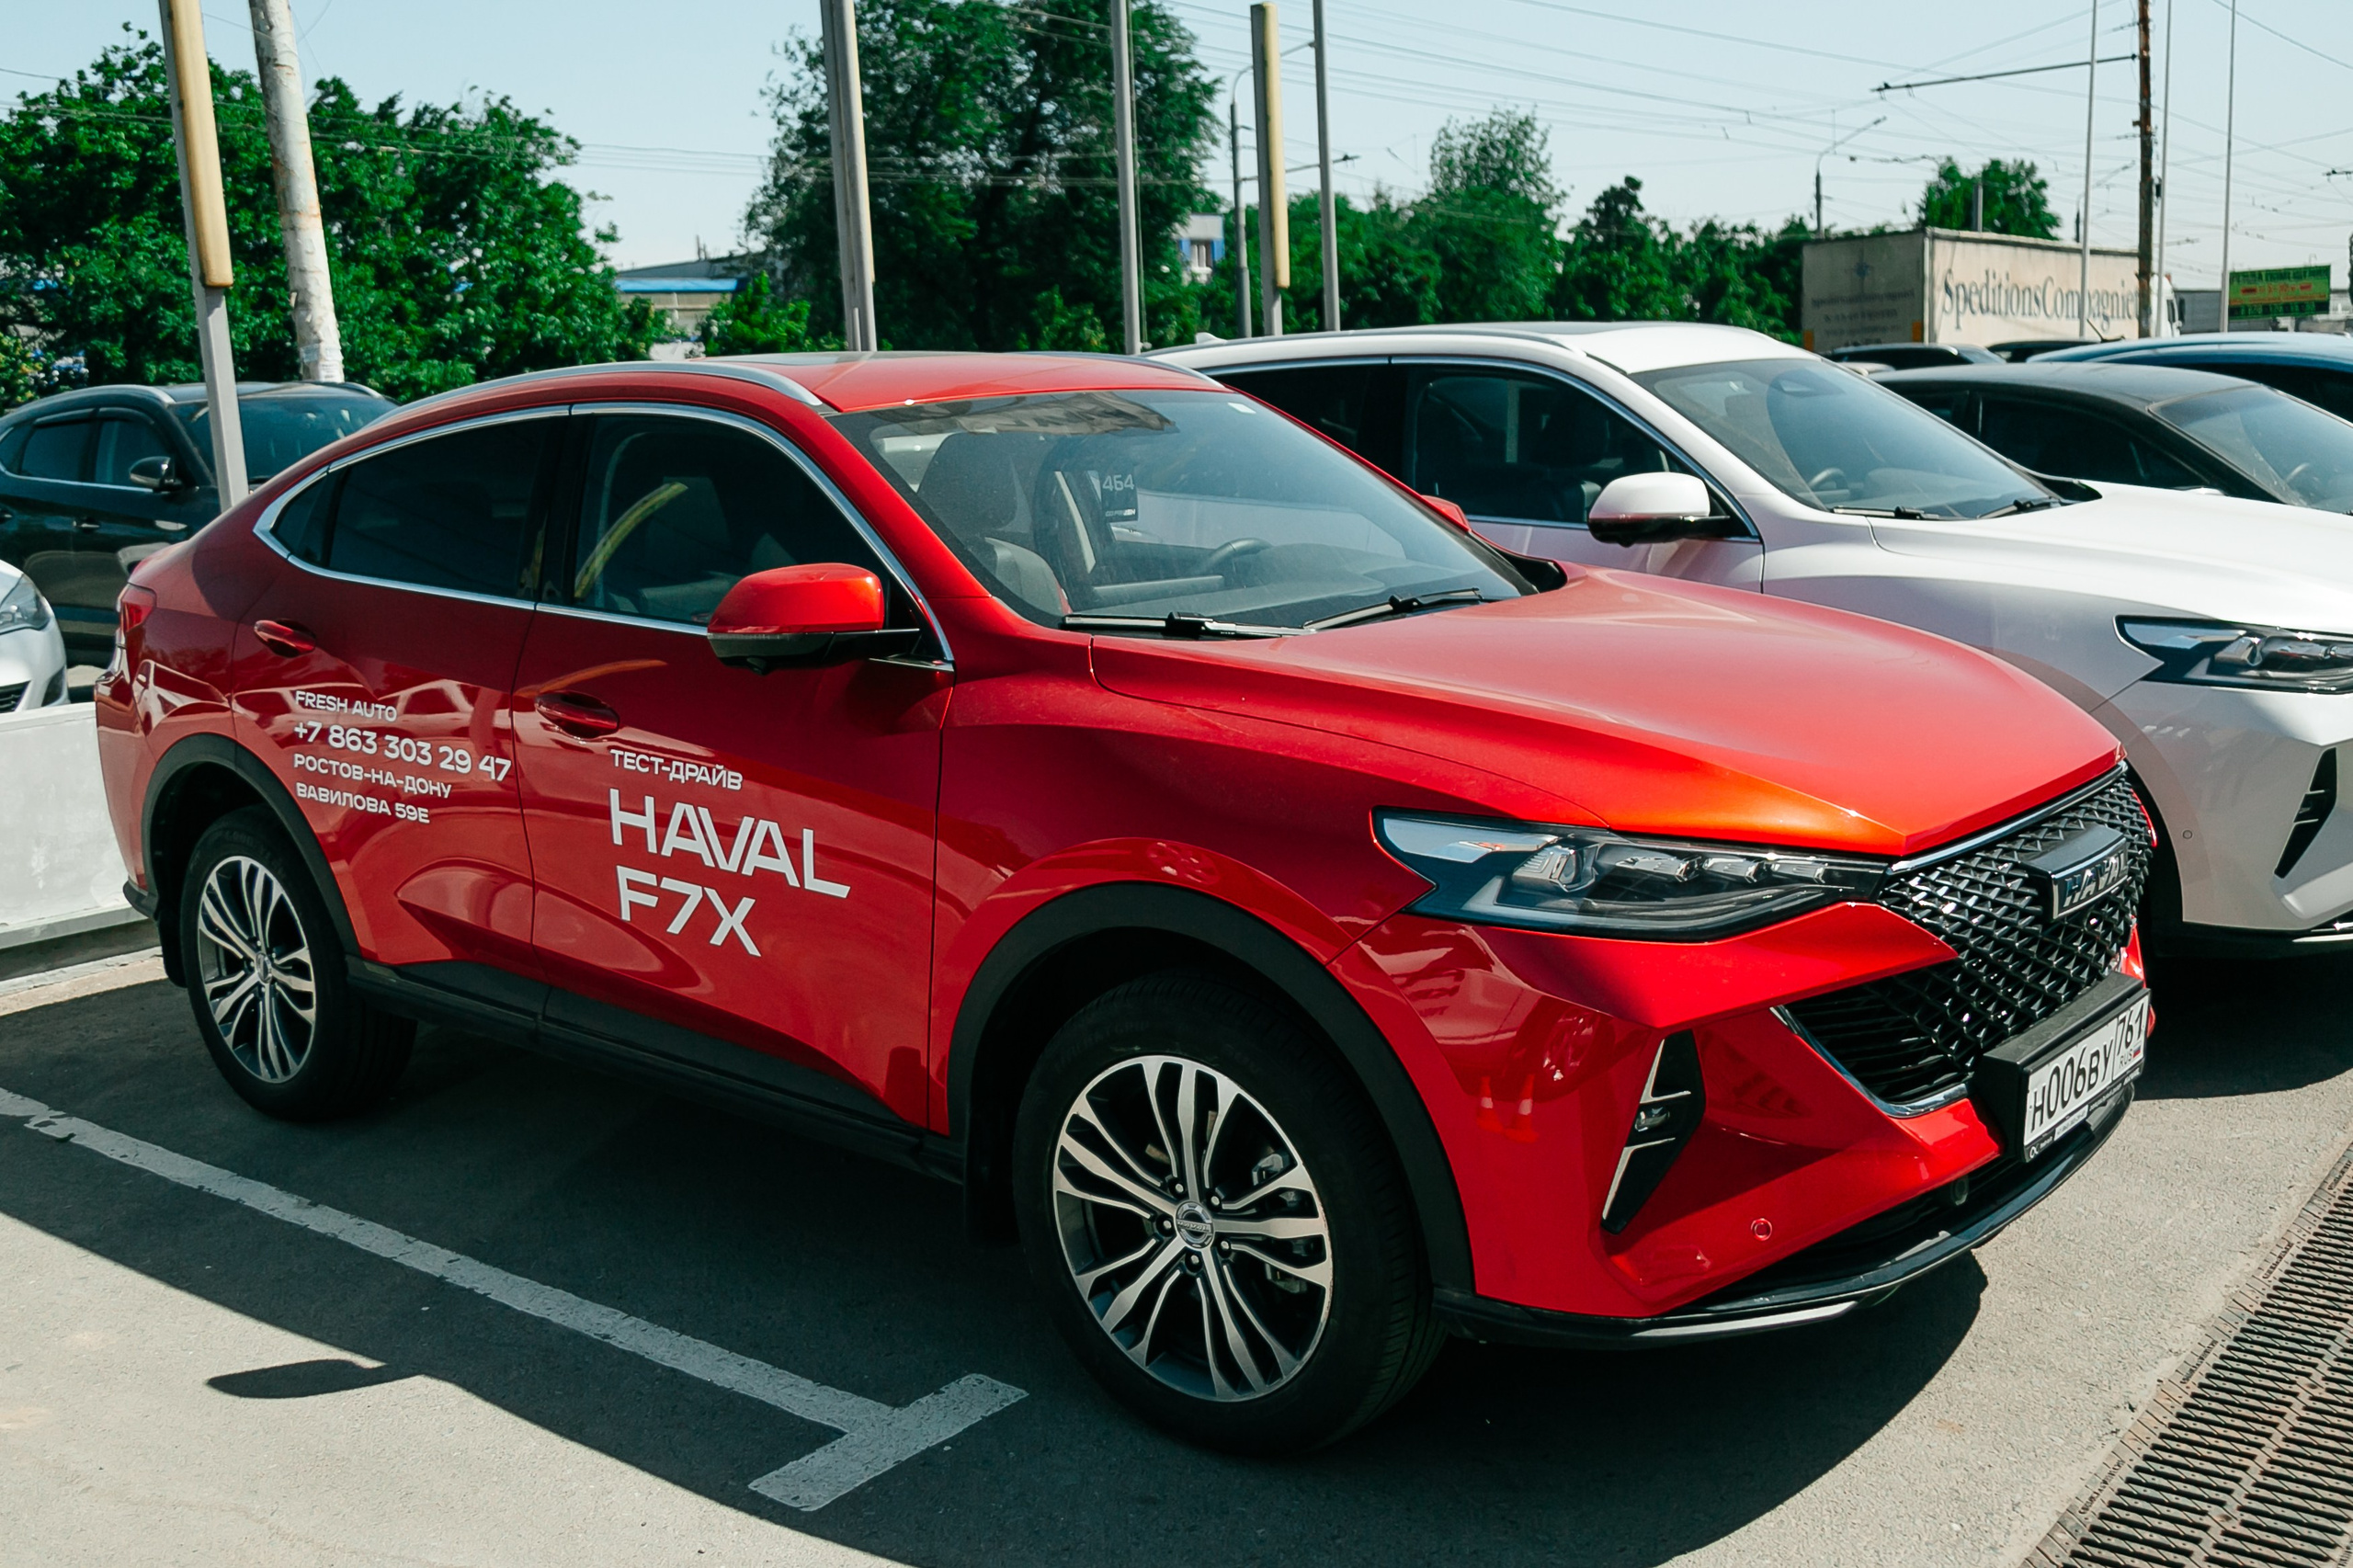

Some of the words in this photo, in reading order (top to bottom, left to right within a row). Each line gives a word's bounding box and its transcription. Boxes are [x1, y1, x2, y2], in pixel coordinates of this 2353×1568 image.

[1943, 267, 2139, 332] SpeditionsComagnie
[1102, 473, 1135, 492] 464
[295, 690, 348, 714] FRESH
[351, 700, 397, 722] AUTO
[294, 721, 322, 743] +7
[328, 724, 378, 755] 863
[384, 734, 433, 766] 303
[438, 745, 472, 774] 29
[478, 756, 512, 781] 47
[609, 749, 744, 790] ТЕСТ-ДРАЙВ
[293, 754, 452, 799] РОСТОВ-НА-ДОНУ
[296, 782, 392, 815] ВАВИЛОВА
[609, 788, 851, 899] HAVAL
[2063, 849, 2128, 908] HAVAL
[616, 865, 762, 957] F7X
[2117, 1003, 2144, 1056] 761
[2119, 1049, 2133, 1069] RUS
